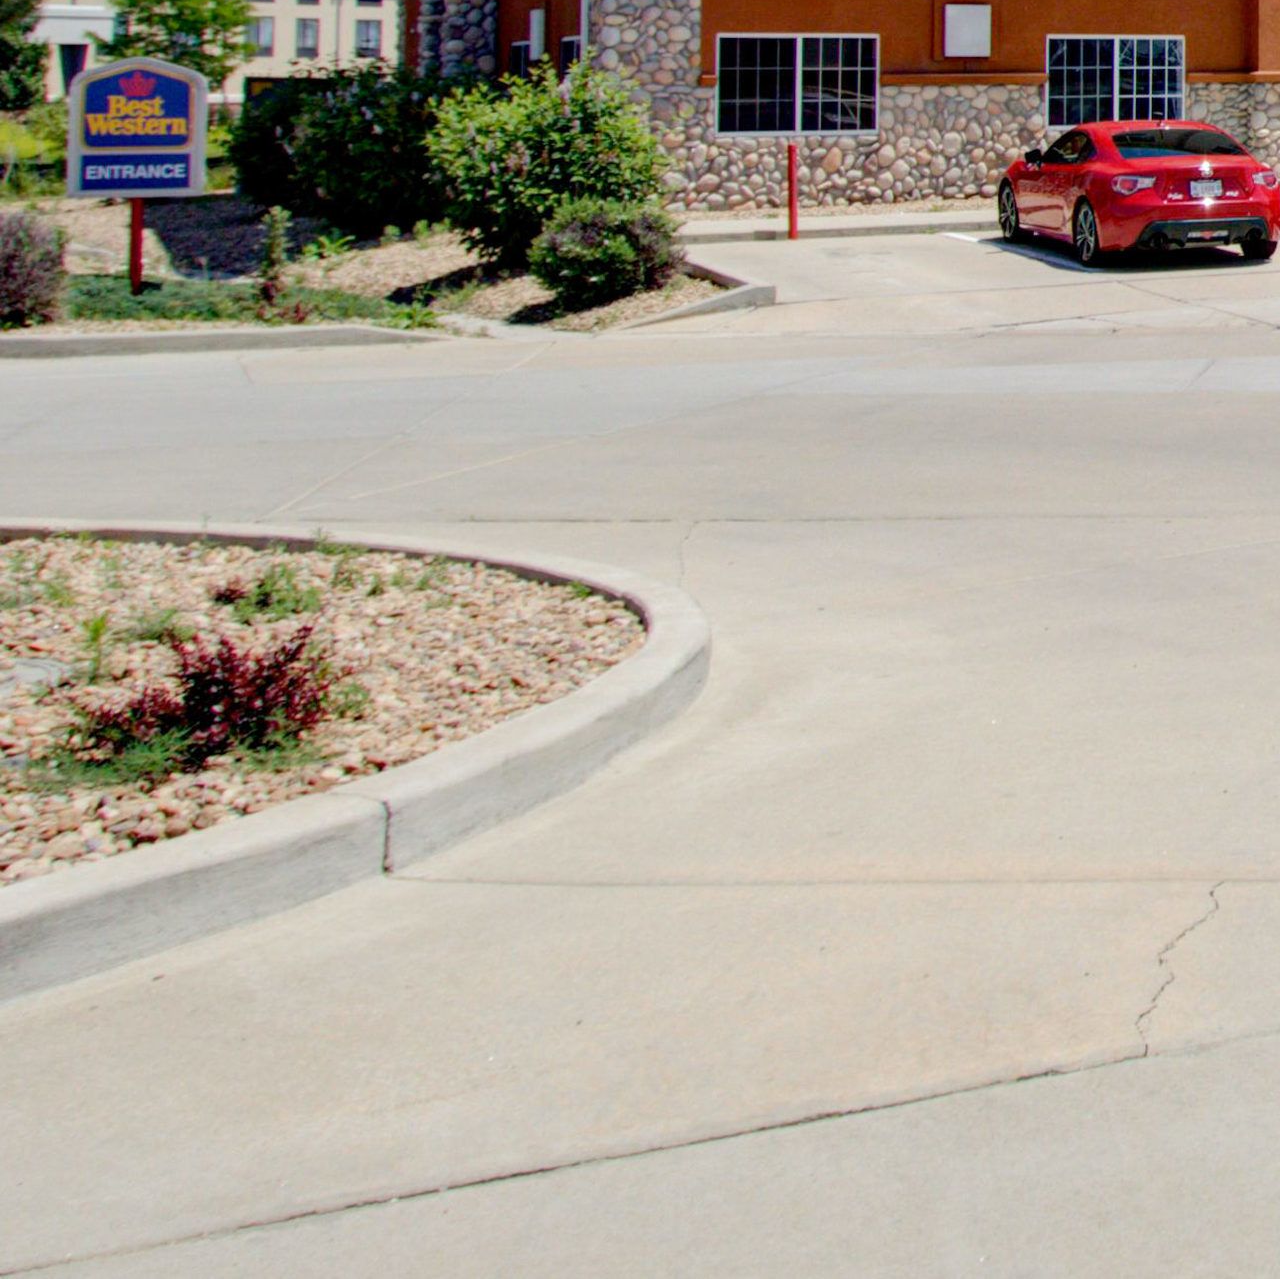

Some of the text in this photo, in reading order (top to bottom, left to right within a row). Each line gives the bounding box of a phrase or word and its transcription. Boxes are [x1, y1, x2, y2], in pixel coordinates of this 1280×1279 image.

[108, 96, 165, 117] Best
[86, 113, 187, 135] Western
[85, 163, 186, 180] ENTRANCE
